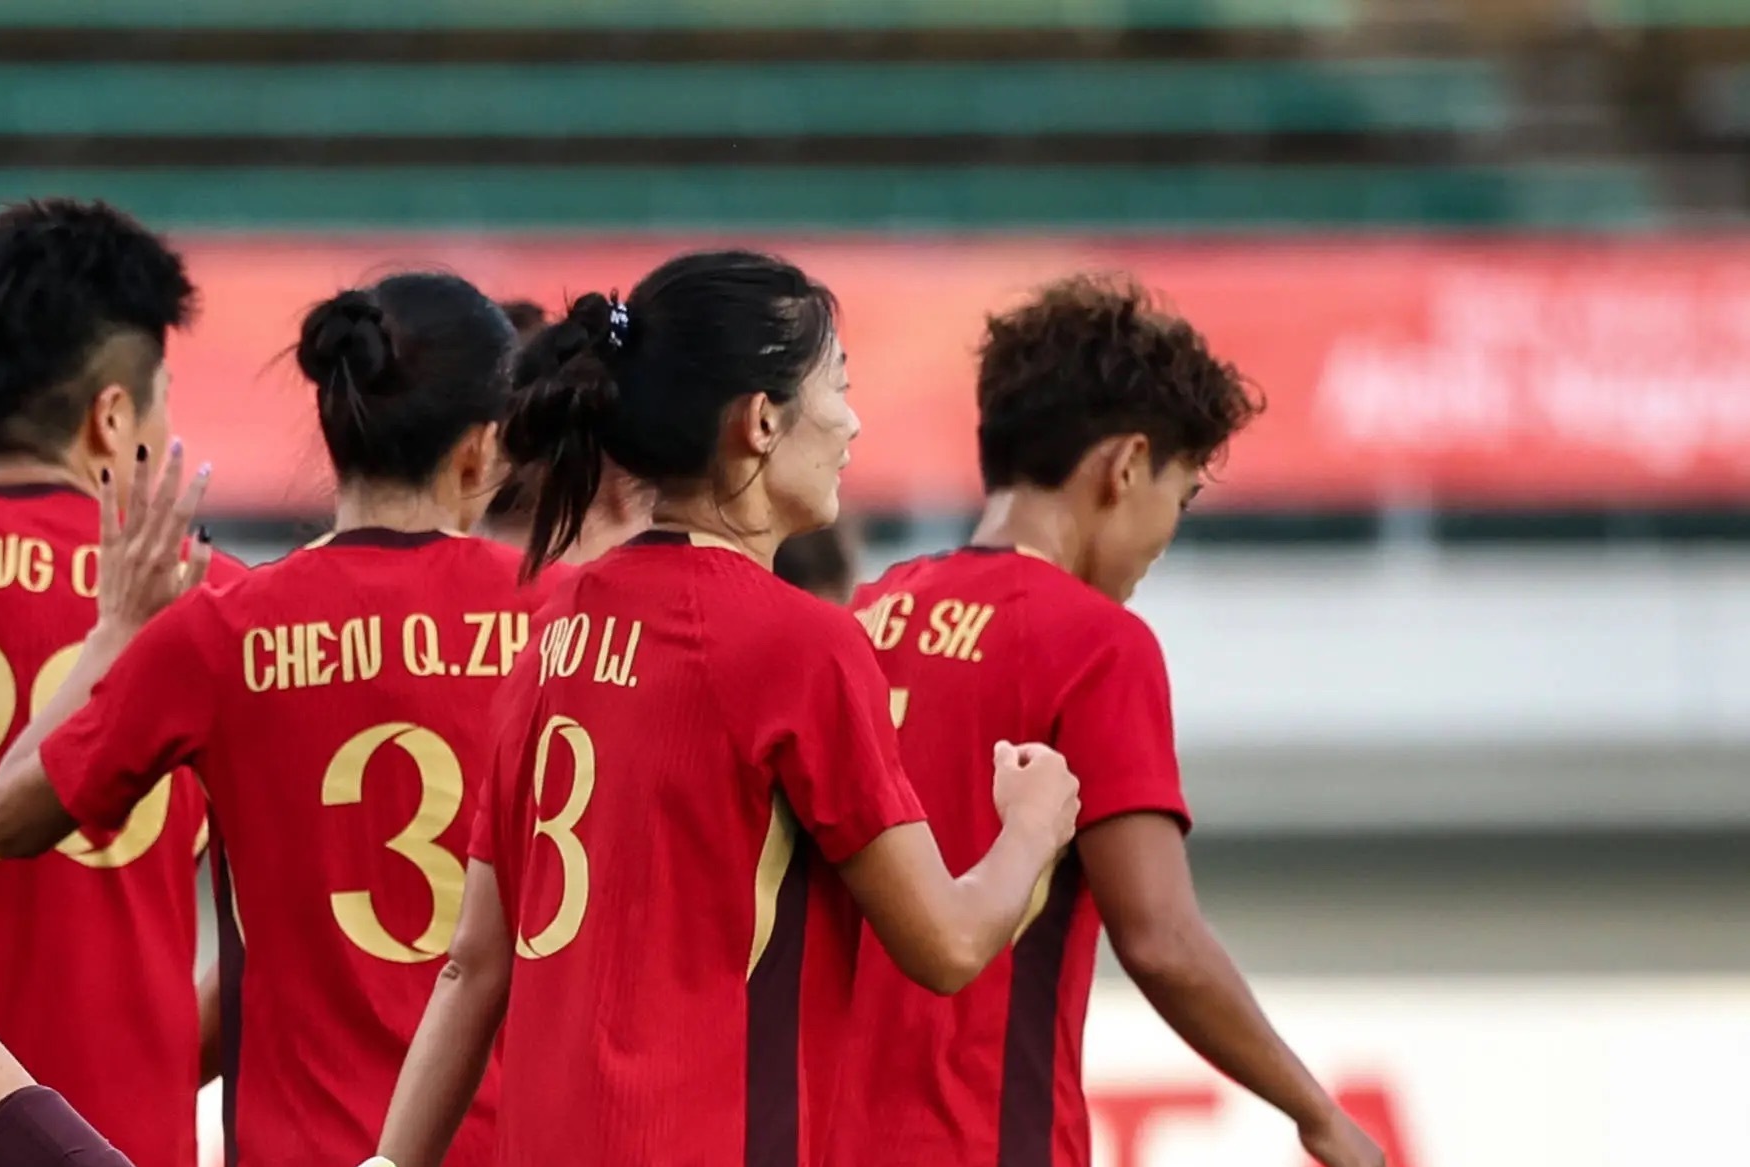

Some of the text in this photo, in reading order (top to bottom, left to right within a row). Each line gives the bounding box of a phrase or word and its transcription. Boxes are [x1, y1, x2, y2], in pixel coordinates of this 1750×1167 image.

[243, 614, 382, 693] CHEN
[594, 617, 642, 688] W.
[919, 599, 995, 662] SH.
[321, 722, 467, 963] 3
